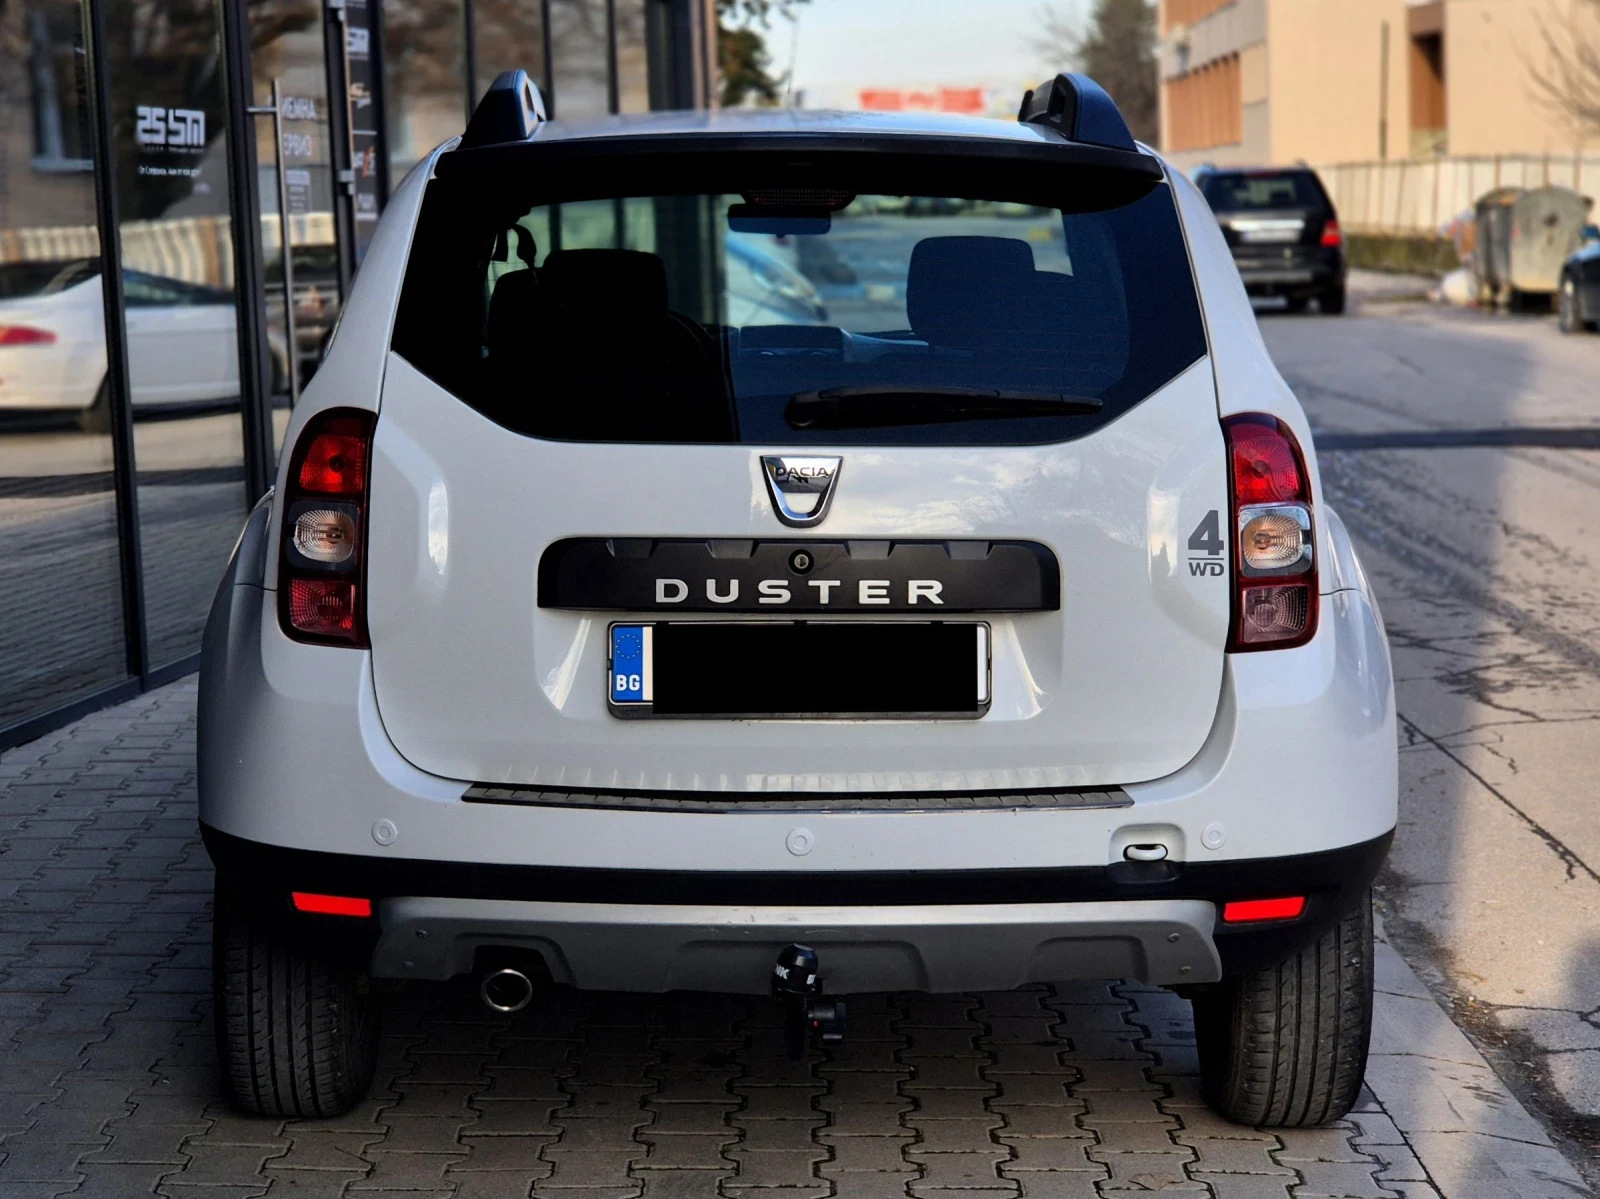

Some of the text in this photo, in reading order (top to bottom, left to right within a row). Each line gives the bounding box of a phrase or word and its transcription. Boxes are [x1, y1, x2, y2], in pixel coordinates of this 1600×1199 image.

[775, 467, 829, 477] DACIA
[1189, 562, 1224, 576] WD
[655, 578, 944, 605] DUSTER
[616, 674, 640, 691] BG
